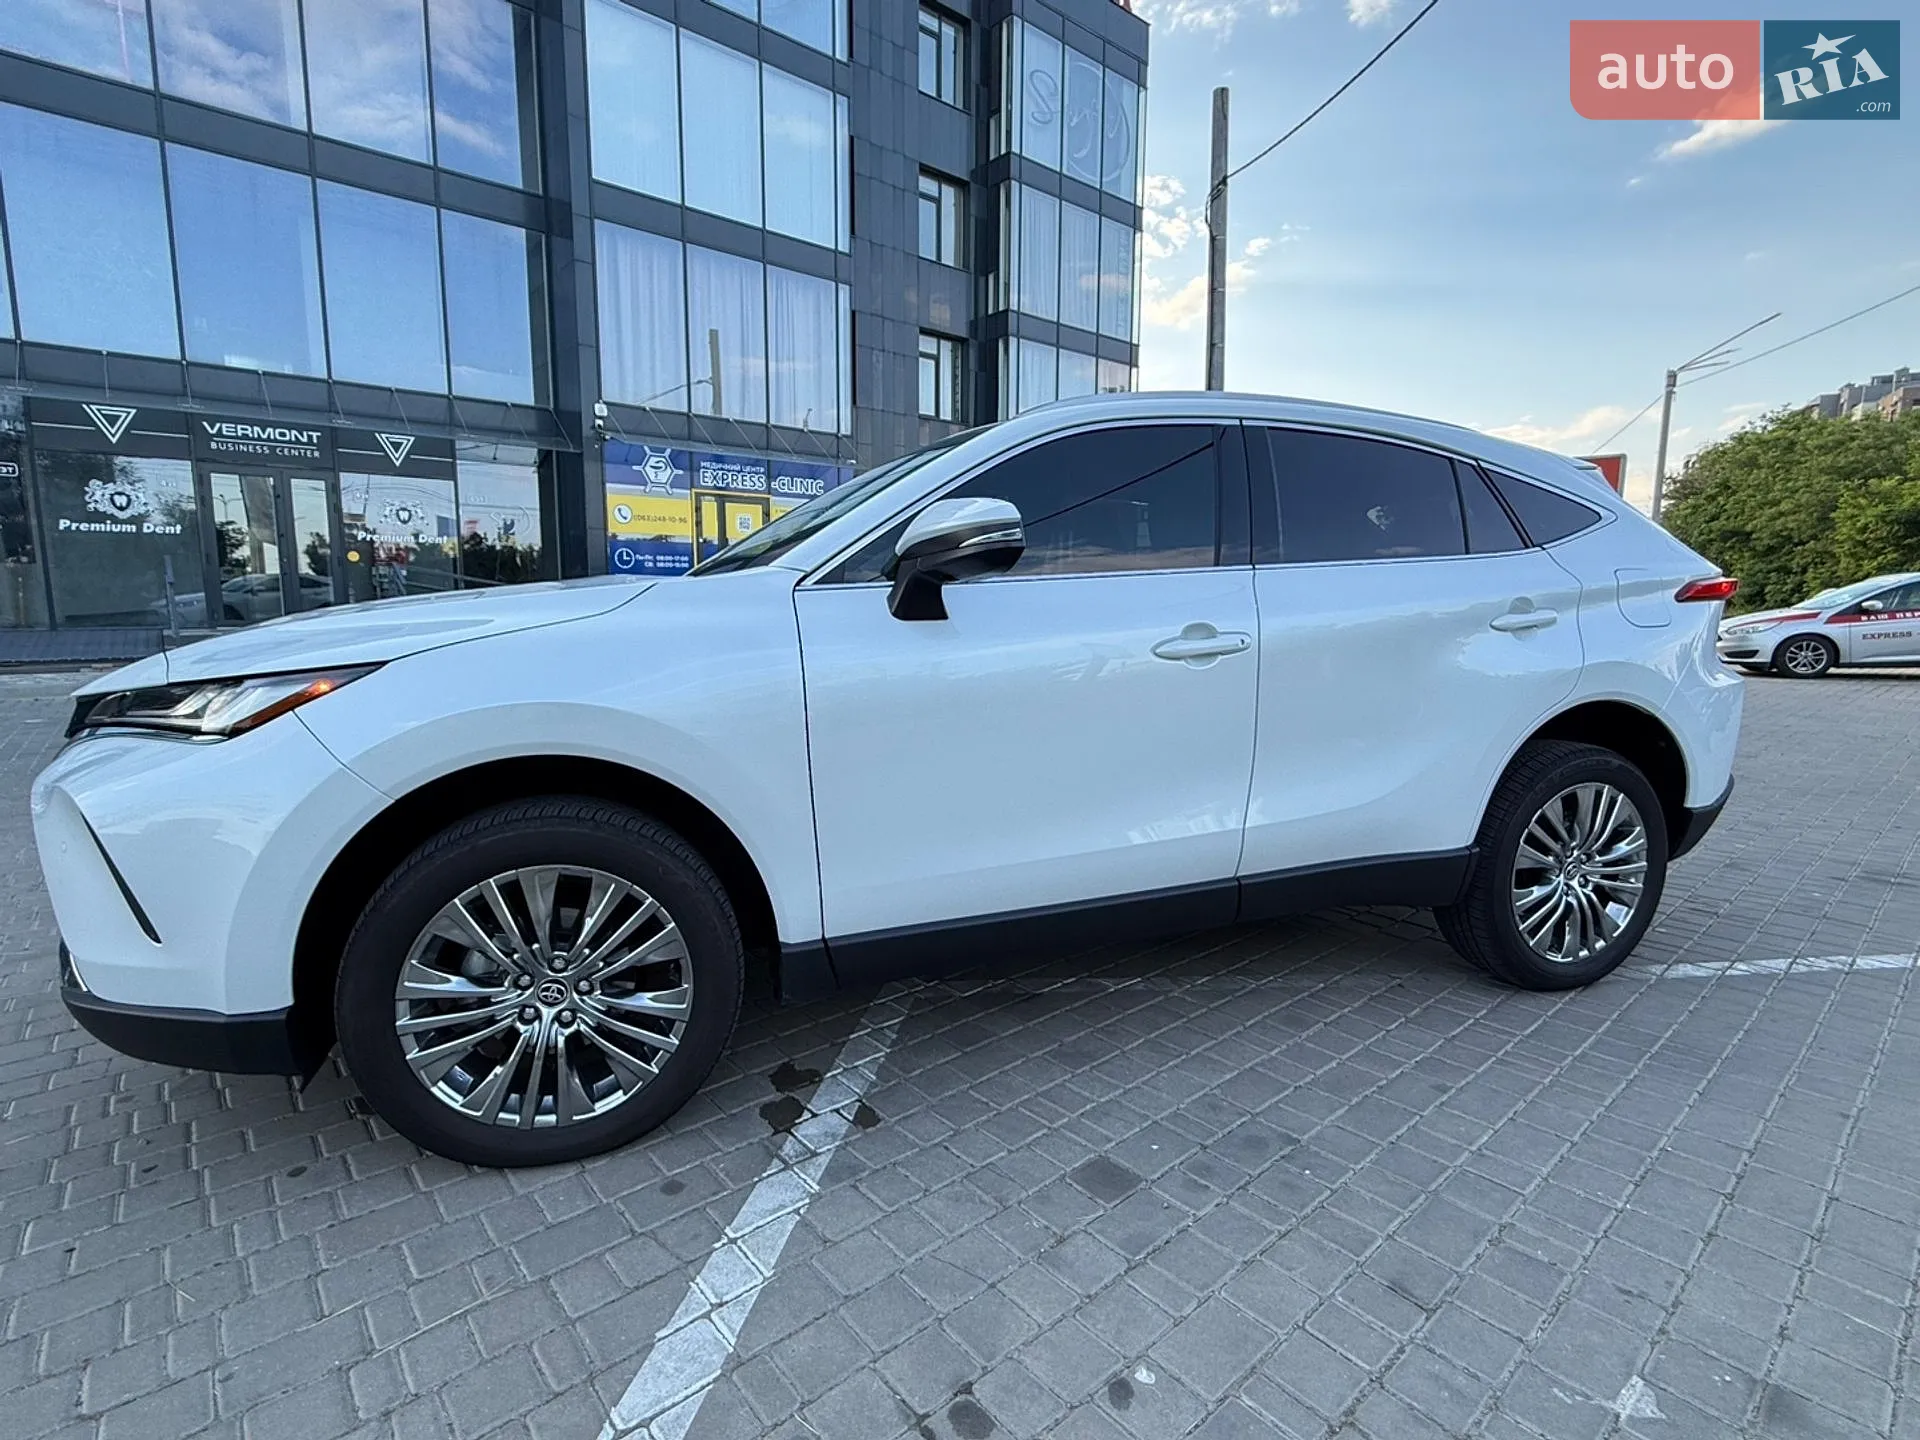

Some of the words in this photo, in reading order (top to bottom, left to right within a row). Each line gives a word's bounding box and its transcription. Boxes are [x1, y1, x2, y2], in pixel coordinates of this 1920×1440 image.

[201, 421, 322, 443] VERMONT
[210, 441, 270, 454] BUSINESS
[276, 448, 321, 458] CENTER
[700, 468, 766, 490] EXPRESS
[58, 519, 137, 533] Premium
[142, 522, 182, 534] Dent
[357, 532, 415, 544] Premium
[418, 534, 448, 544] Dent
[1861, 613, 1888, 621] ВАШ
[1862, 630, 1912, 640] EXPRESS
